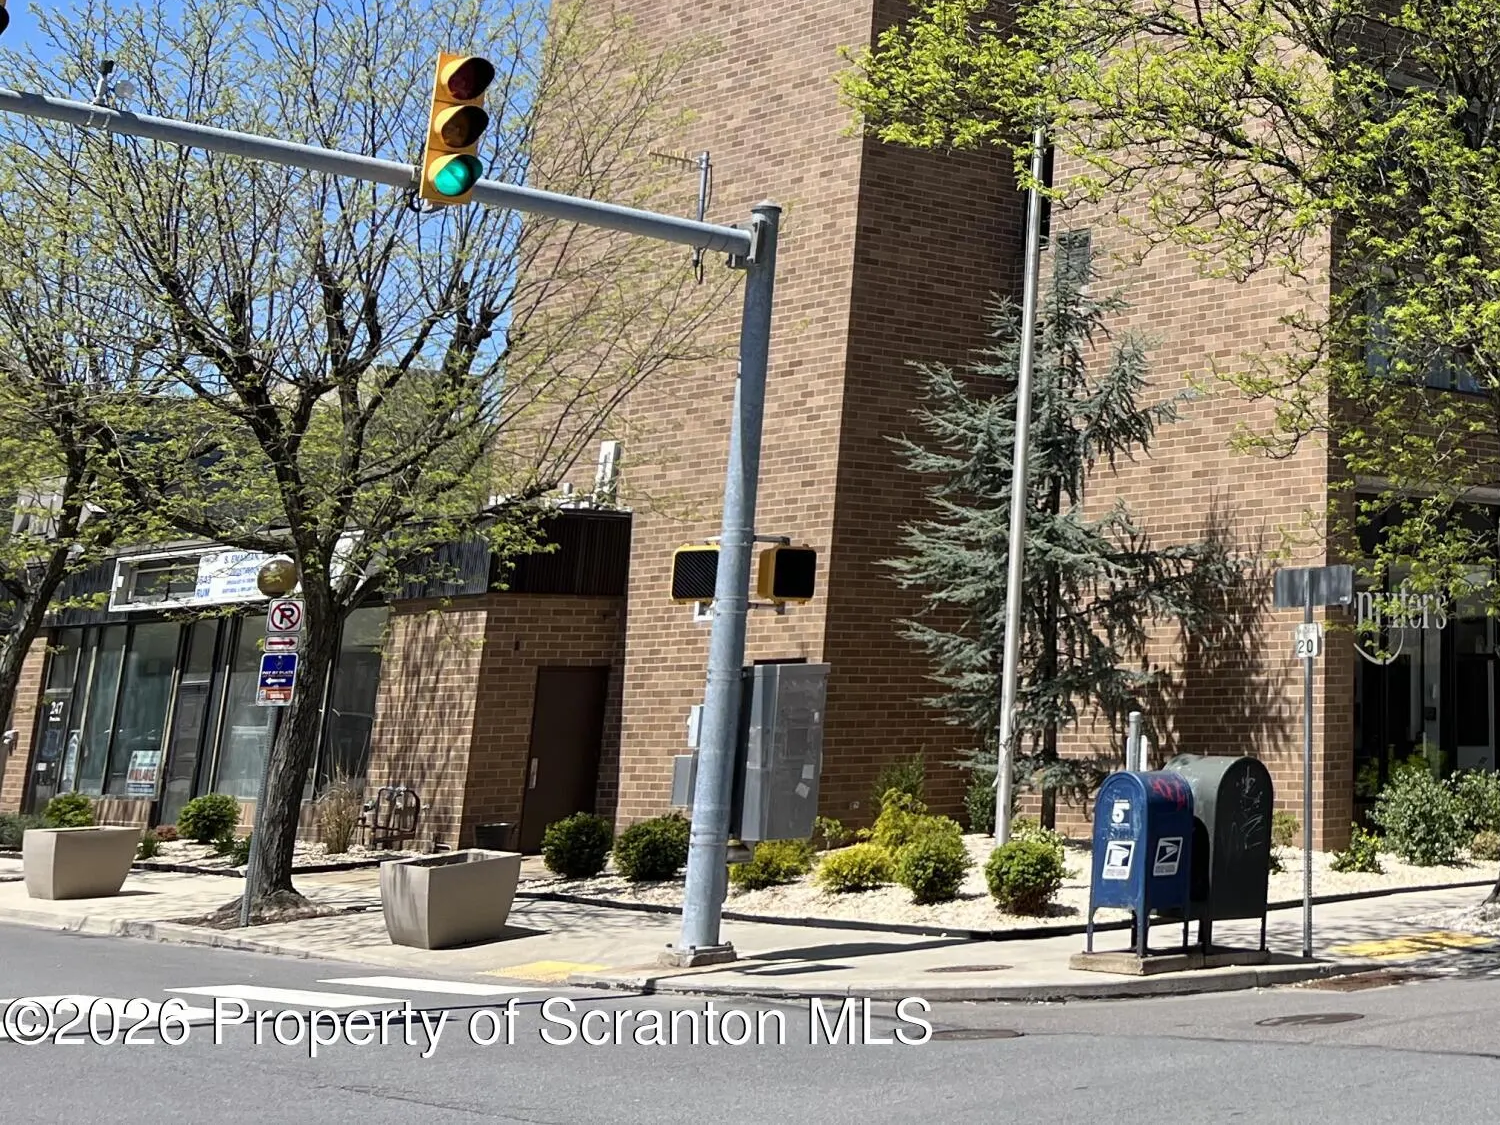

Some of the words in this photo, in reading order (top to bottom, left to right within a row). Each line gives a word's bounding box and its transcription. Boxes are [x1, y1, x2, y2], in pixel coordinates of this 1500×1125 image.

[1297, 638, 1313, 653] 20
[49, 701, 64, 715] 247
[1111, 802, 1130, 823] 5
